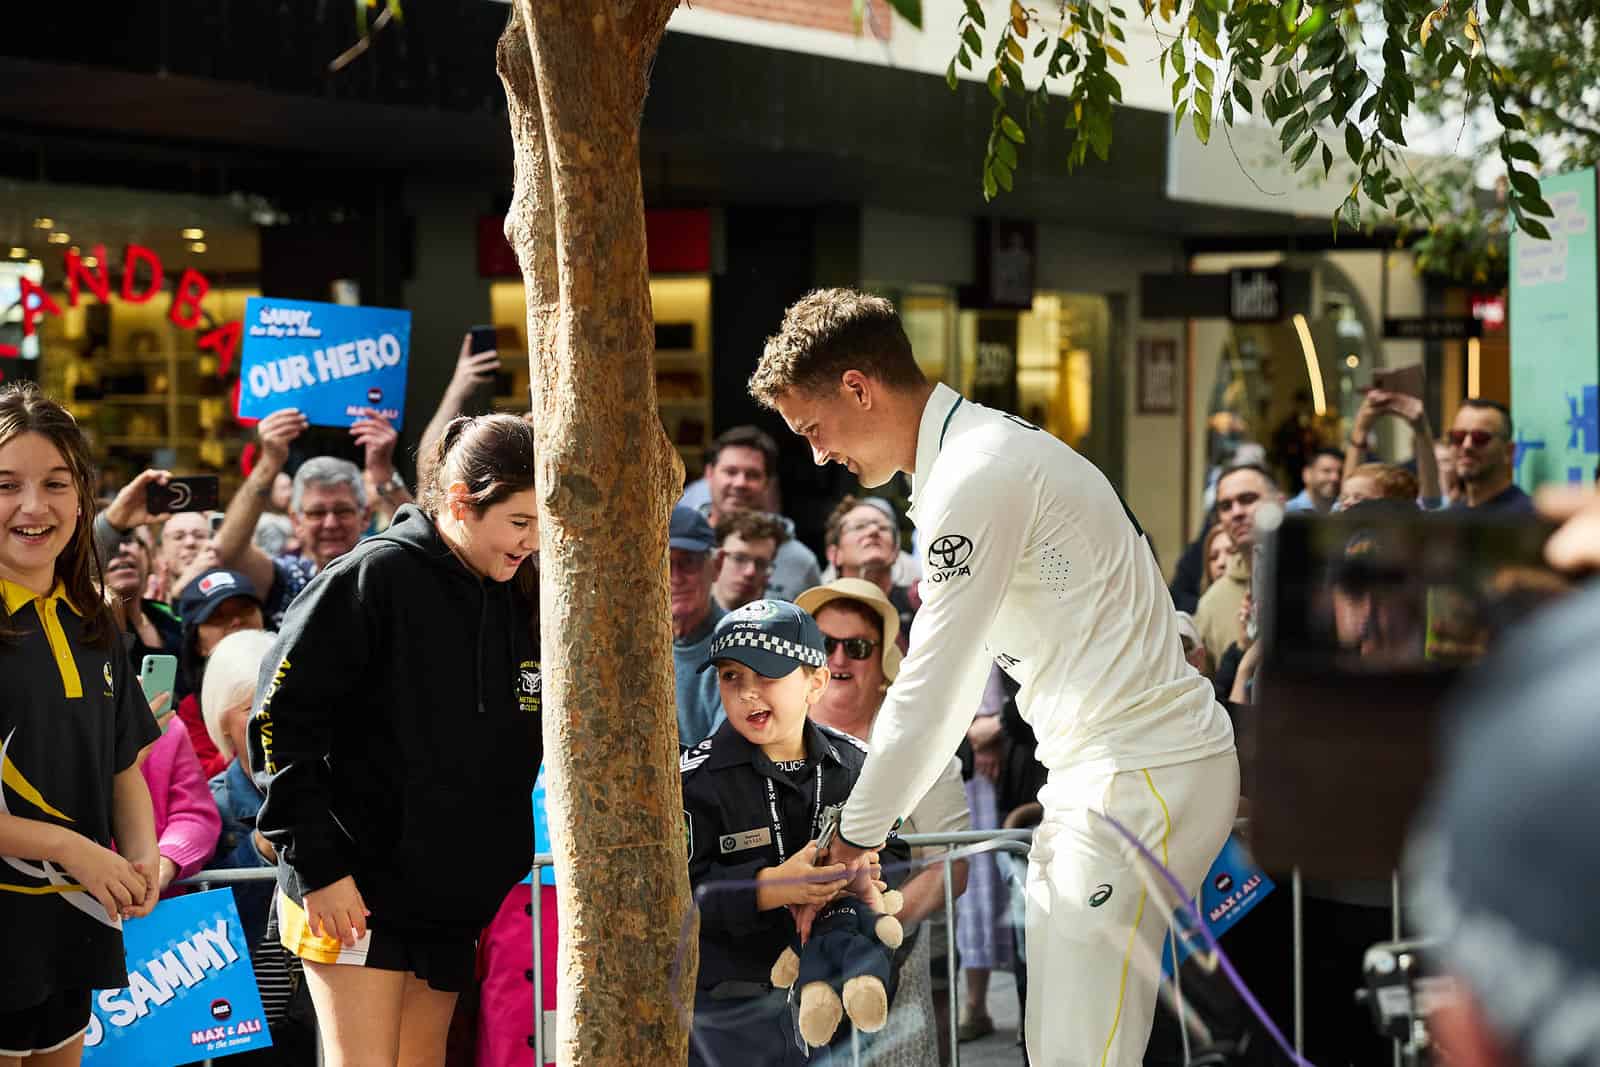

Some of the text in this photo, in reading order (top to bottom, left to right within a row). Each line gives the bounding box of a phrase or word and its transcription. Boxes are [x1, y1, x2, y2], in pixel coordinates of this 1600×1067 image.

[248, 333, 401, 398] OUR HERO
[97, 919, 240, 1027] SAMMY
[191, 1027, 226, 1045] MAX
[237, 1019, 261, 1036] ALI
